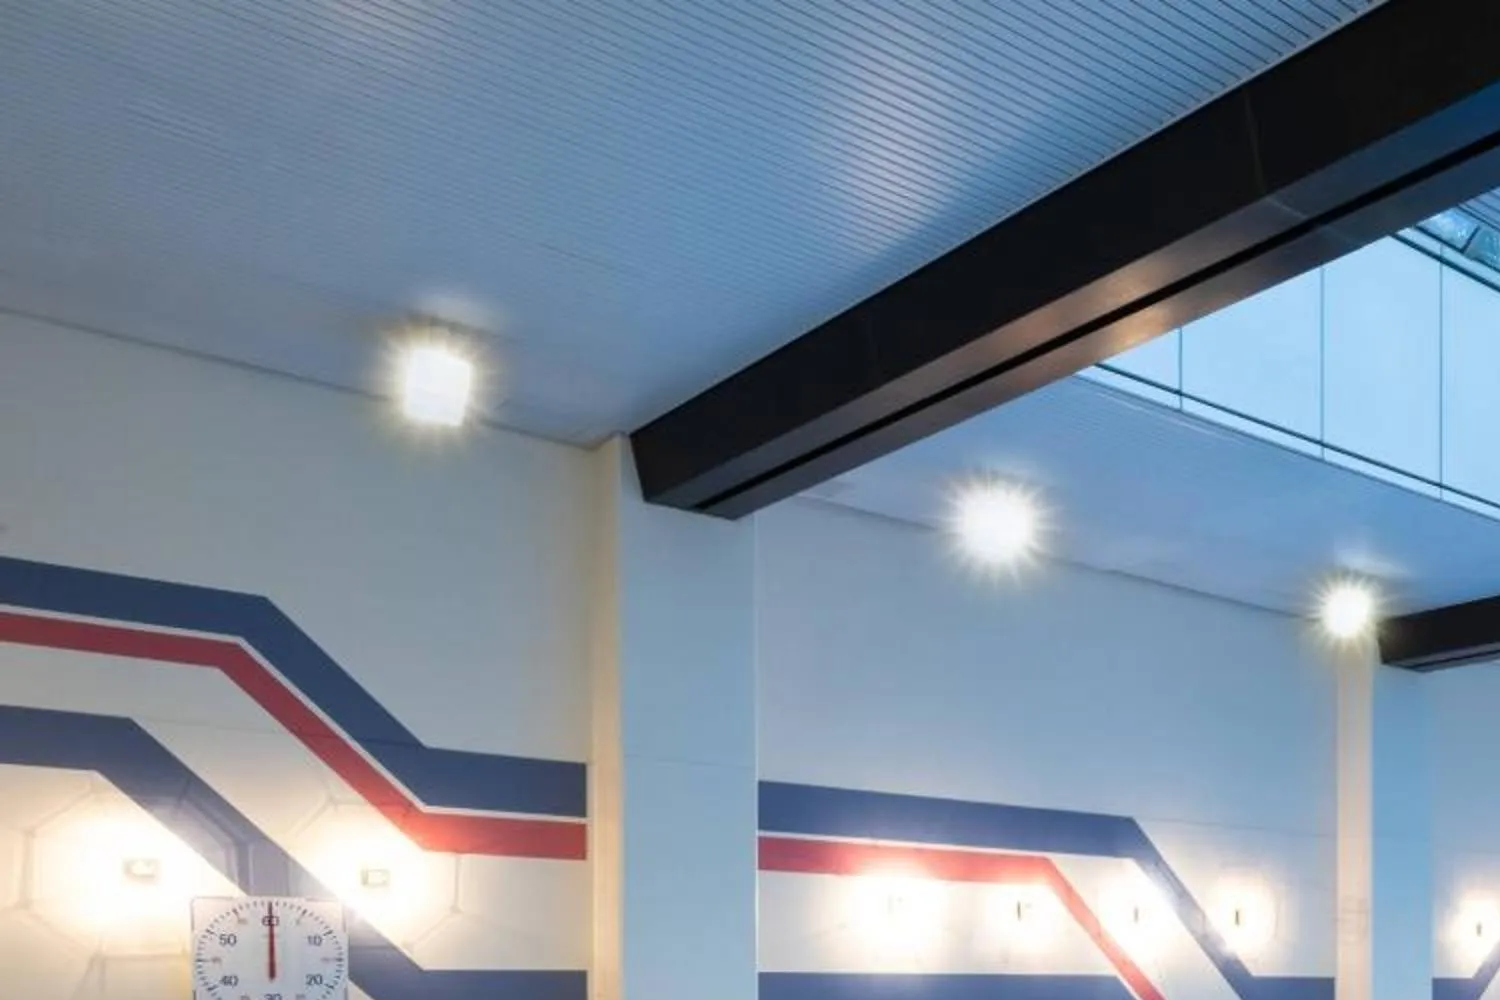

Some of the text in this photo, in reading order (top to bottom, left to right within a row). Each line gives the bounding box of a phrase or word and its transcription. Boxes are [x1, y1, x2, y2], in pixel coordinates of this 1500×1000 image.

[219, 933, 237, 946] 50
[307, 935, 322, 946] 10
[220, 975, 239, 987] 40
[305, 974, 323, 986] 20
